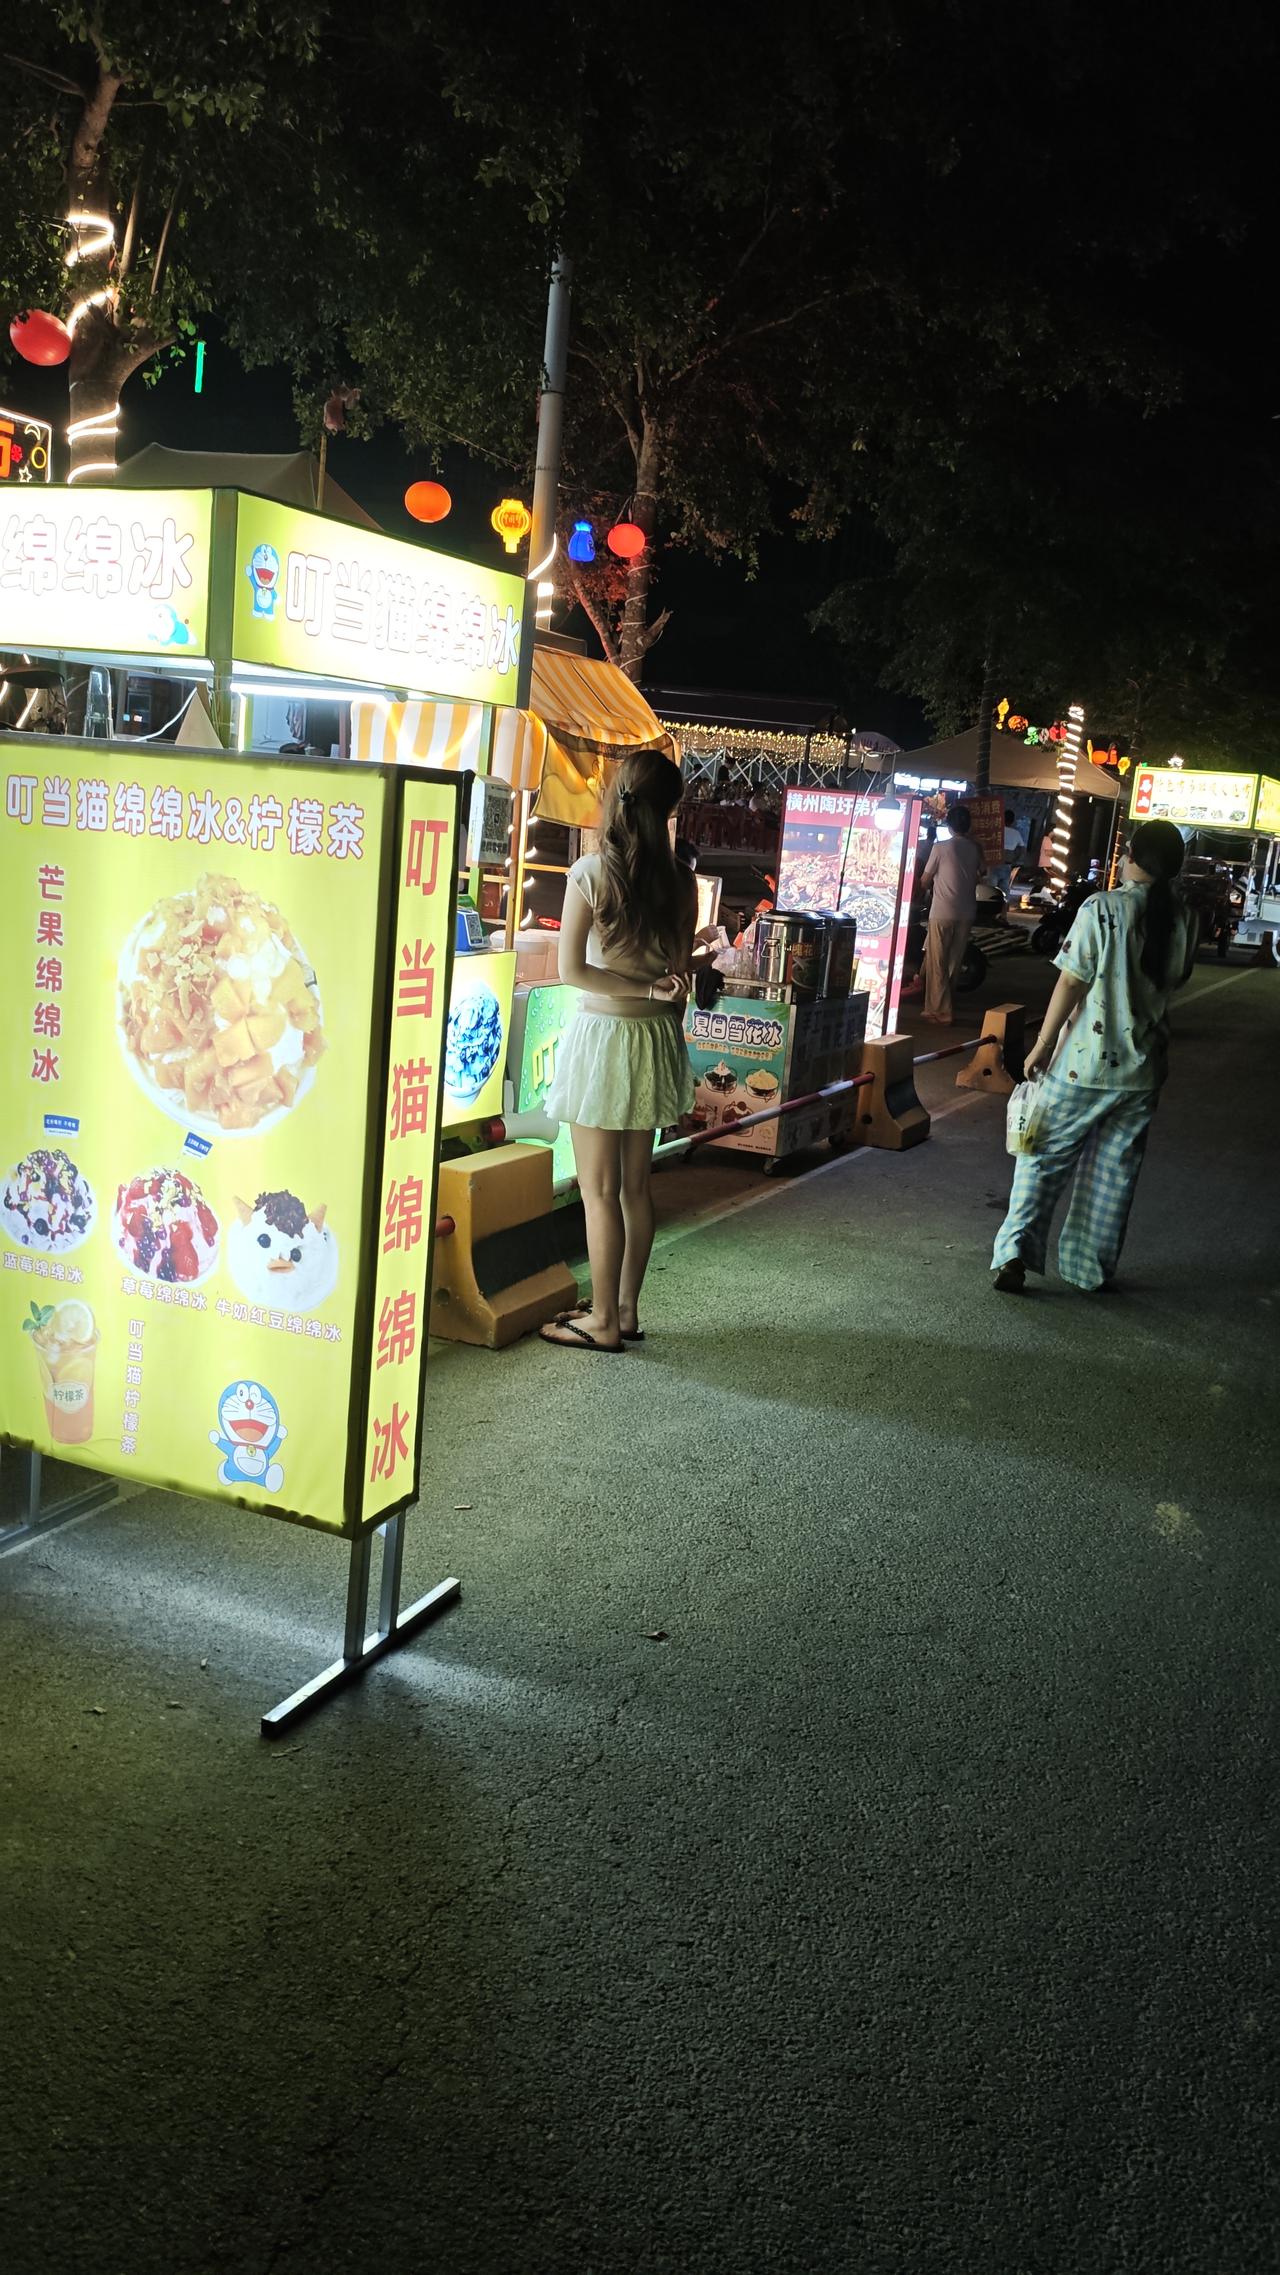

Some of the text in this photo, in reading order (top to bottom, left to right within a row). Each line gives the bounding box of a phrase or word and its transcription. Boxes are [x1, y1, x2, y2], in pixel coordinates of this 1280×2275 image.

[1, 514, 195, 600] 绵绵冰
[285, 550, 522, 676] 叮当猫绵绵冰
[5, 774, 365, 860] 叮当猫绵绵冰&柠檬茶
[31, 863, 65, 1083] 芒果绵绵冰
[692, 1010, 784, 1047] 夏日雪花冰
[369, 818, 449, 1484] 叮当猫绵绵冰
[4, 1251, 84, 1284] 蓝莓绵绵冰
[121, 1276, 208, 1312] 草莓绵绵冰
[215, 1297, 342, 1343] 牛奶红豆绵绵冰
[120, 1319, 146, 1456] 叮当猫柠檬茶
